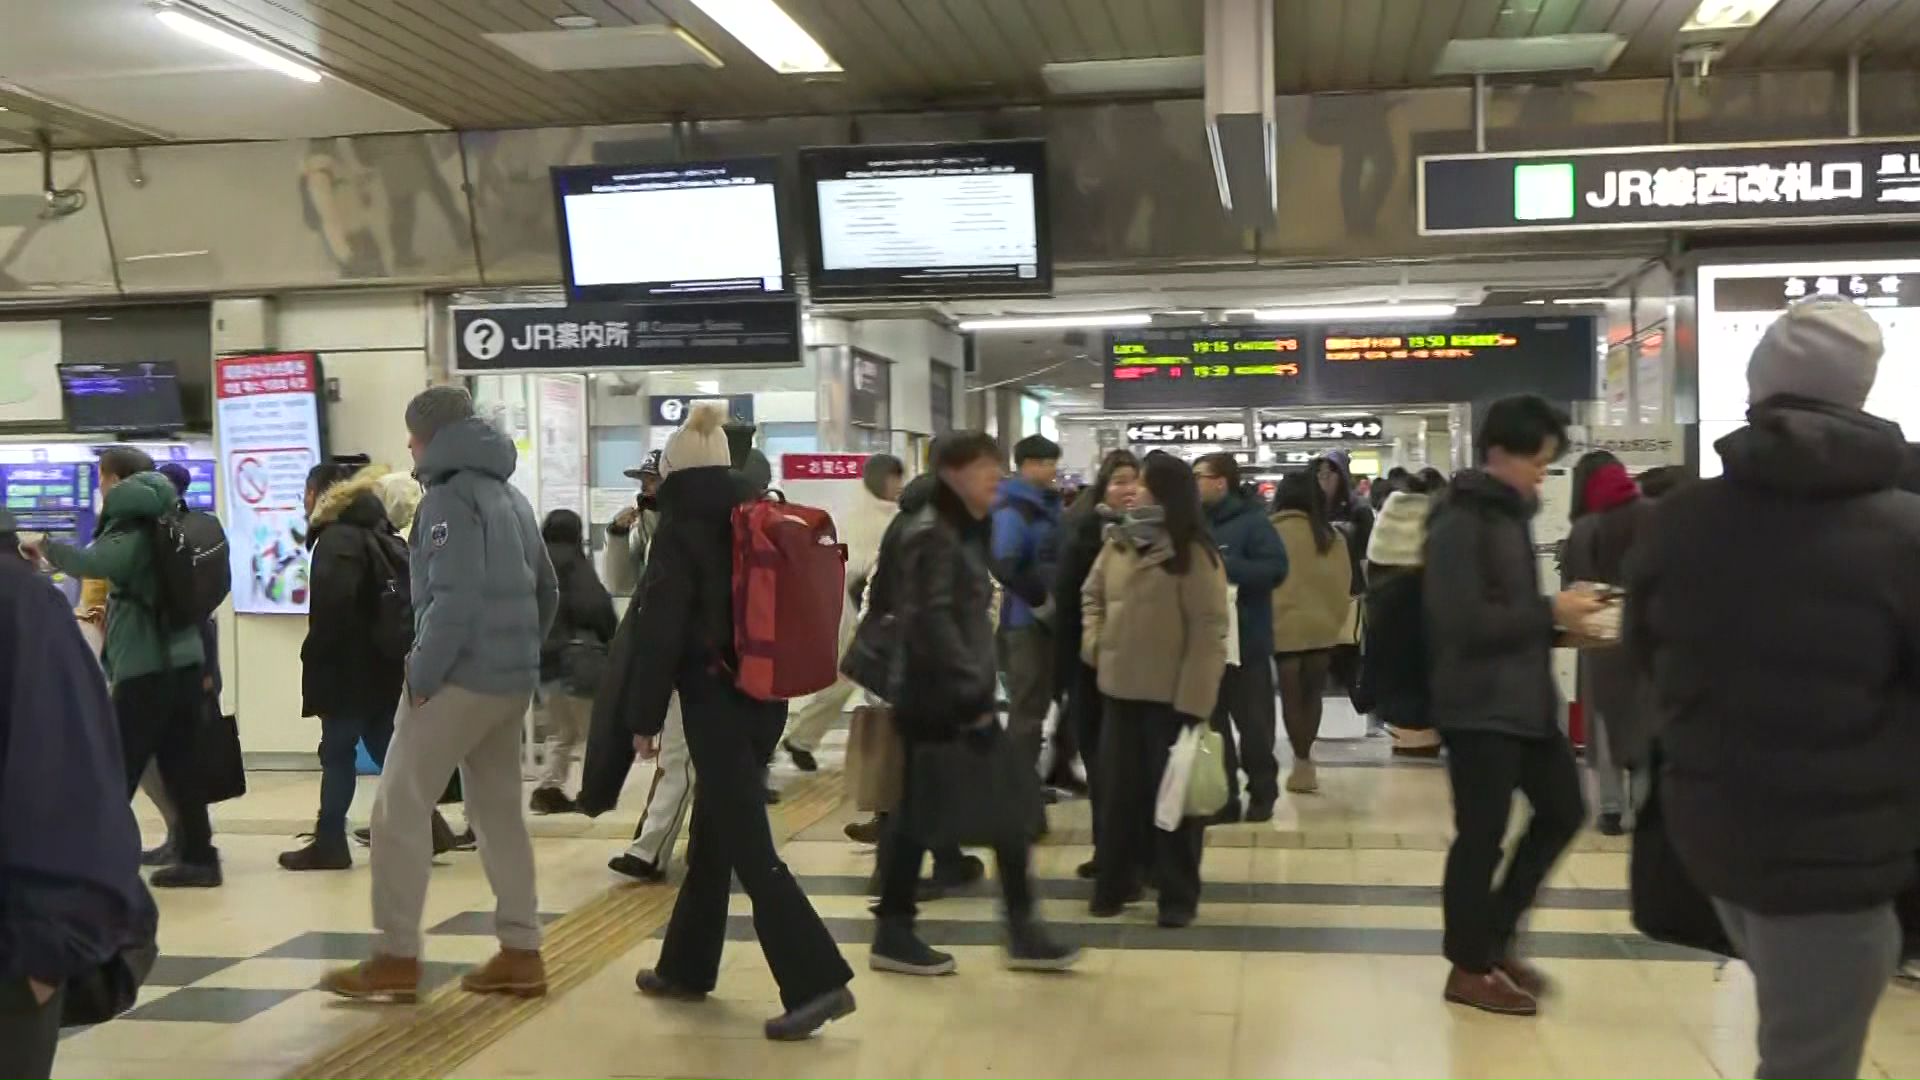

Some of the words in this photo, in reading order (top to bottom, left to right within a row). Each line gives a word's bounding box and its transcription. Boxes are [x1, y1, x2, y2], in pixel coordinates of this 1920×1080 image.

[1586, 162, 1863, 208] JR線西改札口
[511, 321, 630, 350] JR案内所
